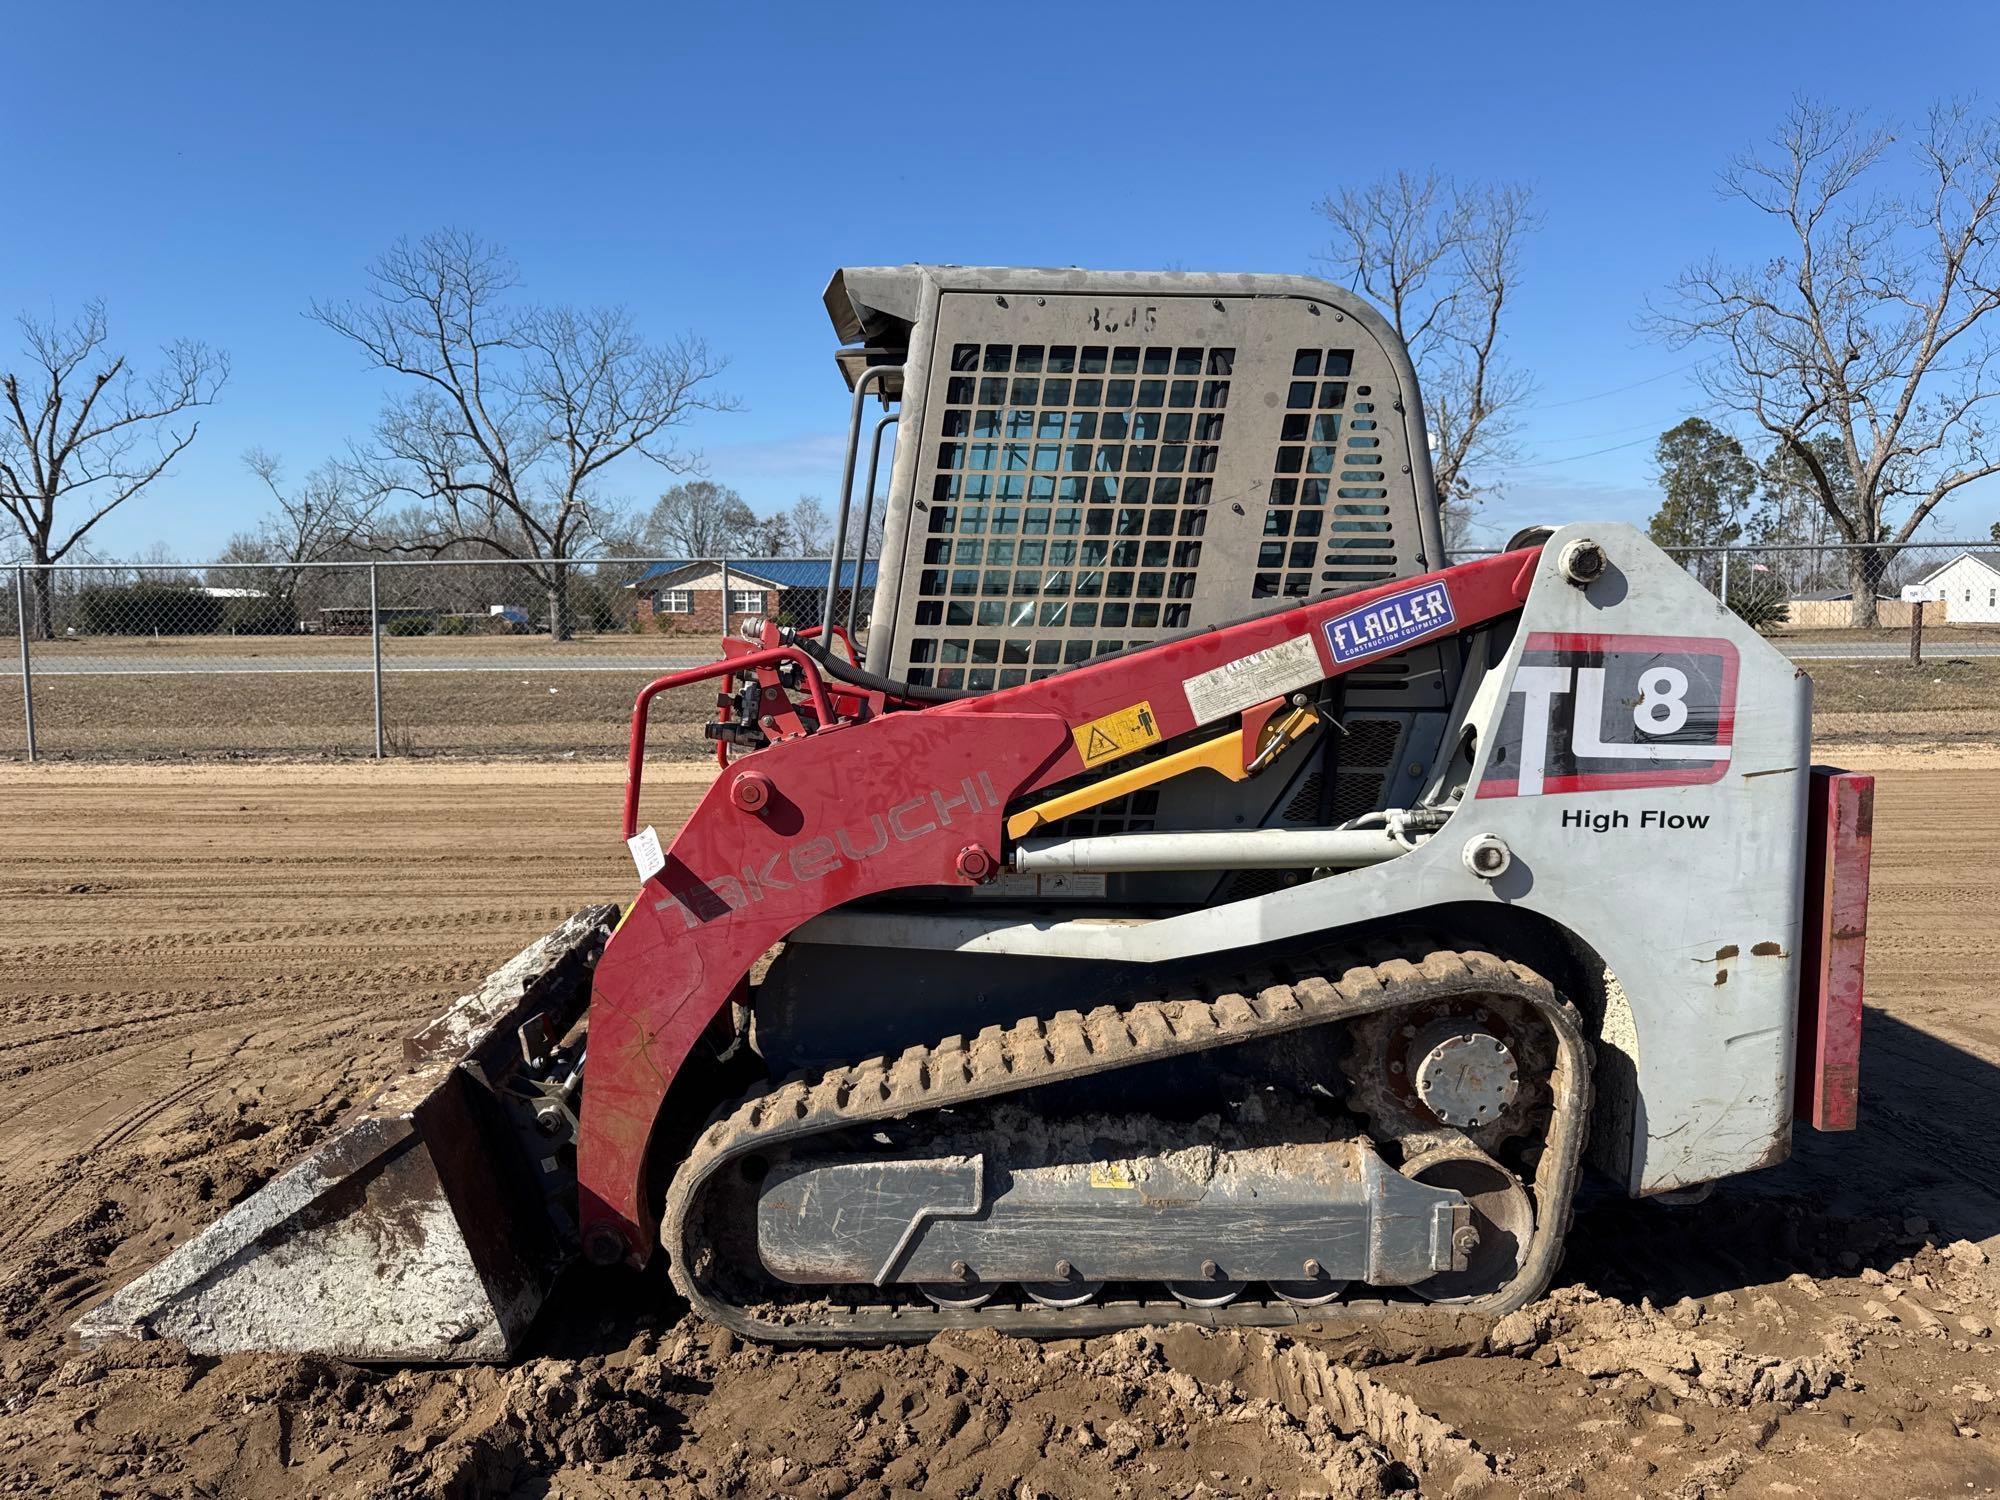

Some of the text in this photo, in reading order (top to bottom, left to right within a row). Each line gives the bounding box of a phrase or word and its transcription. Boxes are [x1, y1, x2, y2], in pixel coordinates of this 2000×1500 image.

[1334, 590, 1446, 650] FLAGLER
[1345, 616, 1442, 656] CONSTRUCTION EQUIPMENT
[1510, 666, 1732, 796] TL8
[1561, 810, 1710, 832] High Flow
